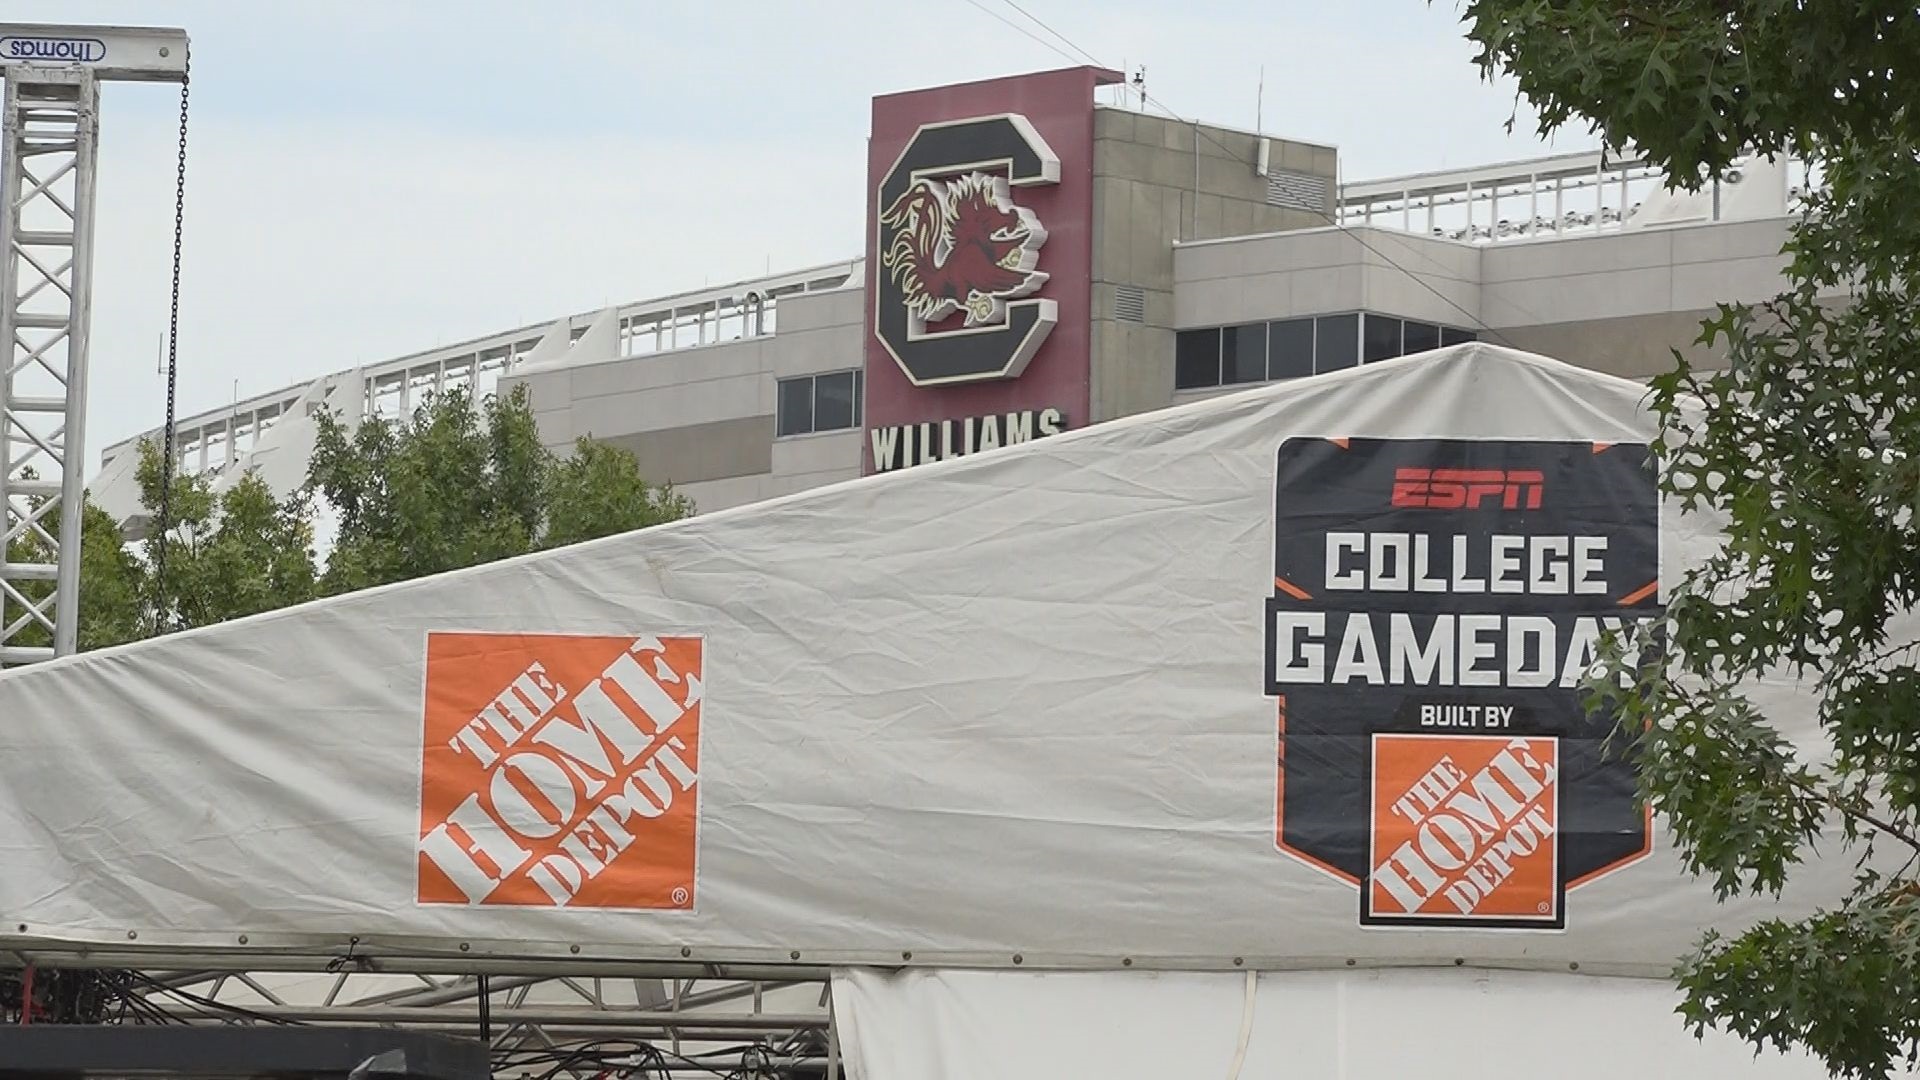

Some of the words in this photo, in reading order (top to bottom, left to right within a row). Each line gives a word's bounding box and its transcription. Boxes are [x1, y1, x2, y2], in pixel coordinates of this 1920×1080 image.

[11, 40, 97, 61] Thomas
[871, 408, 1061, 471] WILLIAMS
[1391, 468, 1544, 510] ESPN
[1325, 532, 1608, 594] COLLEGE
[448, 661, 567, 770] THE
[1421, 705, 1481, 727] BUILT
[1486, 706, 1513, 728] BY
[418, 636, 703, 906] HOME
[1392, 754, 1468, 825] THE
[525, 736, 699, 907] DEPOT
[1373, 736, 1557, 915] HOME
[1443, 804, 1556, 916] DEPOT
